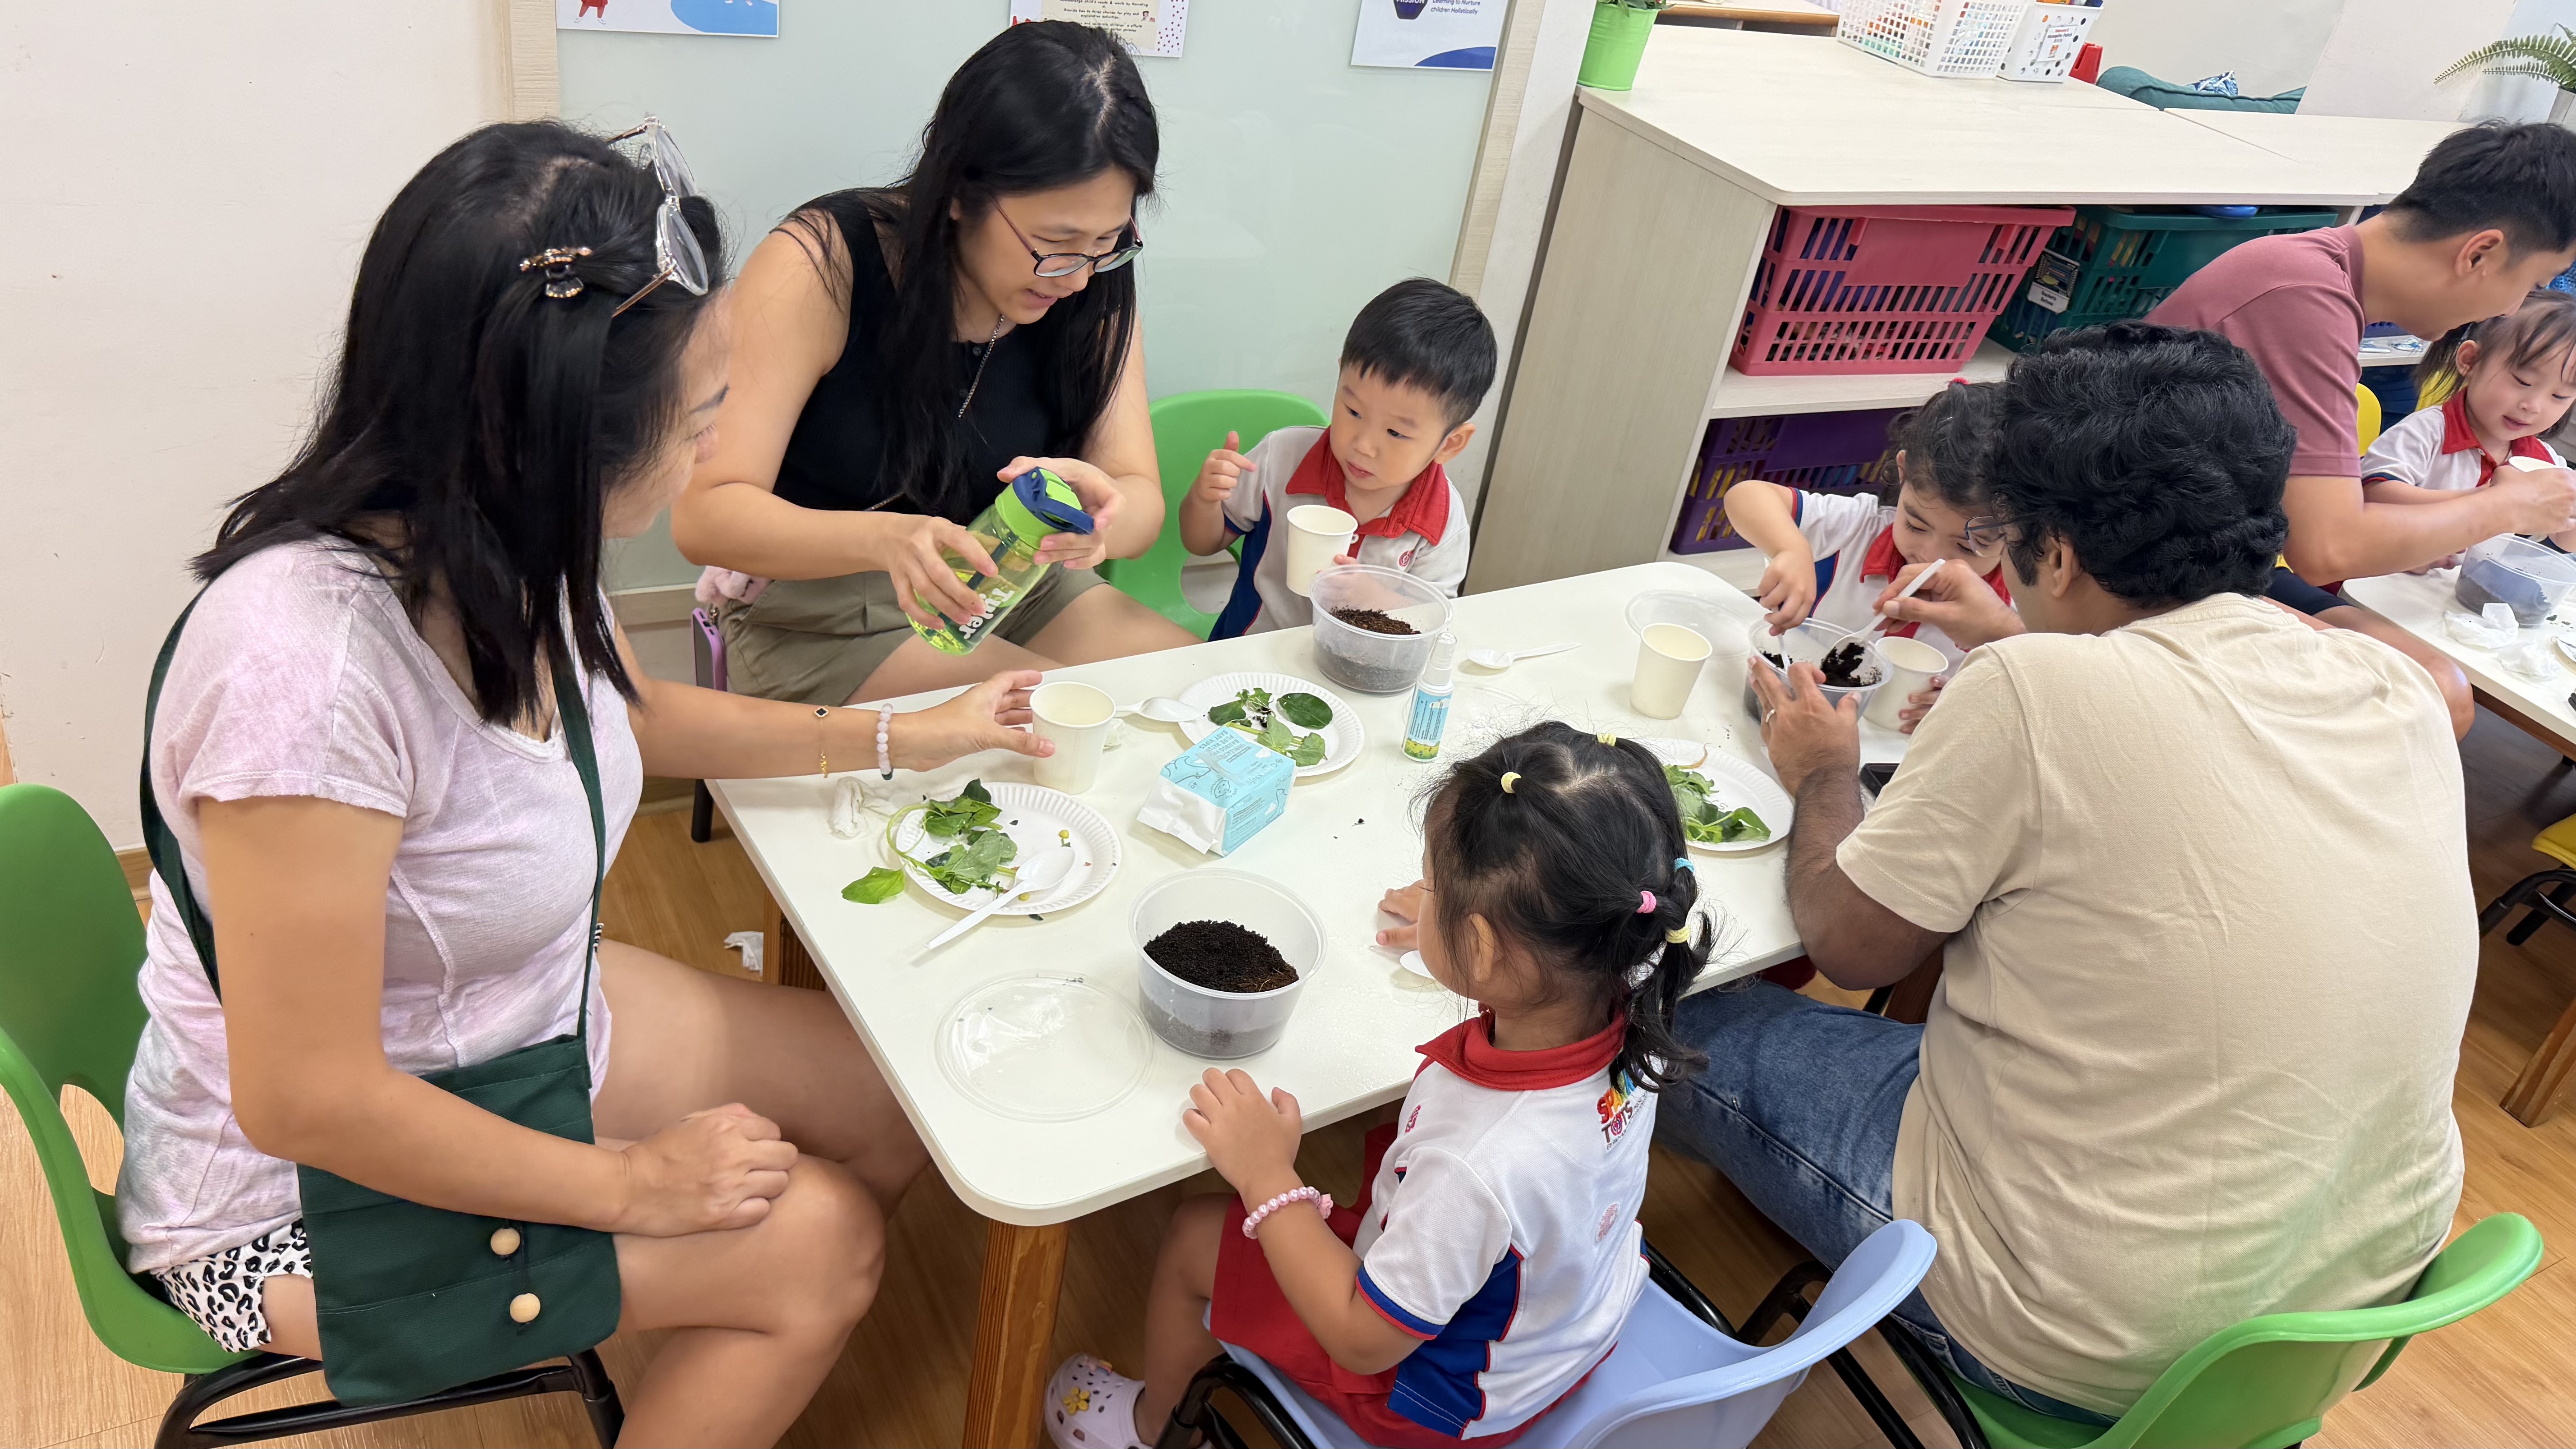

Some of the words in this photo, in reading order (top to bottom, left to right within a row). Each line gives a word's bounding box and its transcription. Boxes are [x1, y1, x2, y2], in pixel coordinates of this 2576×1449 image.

[1213, 730, 1228, 740] BABY
[1219, 734, 1234, 744] PURE
[1199, 738, 1215, 749] WIPES
[1218, 739, 1240, 752] BAMBOO
